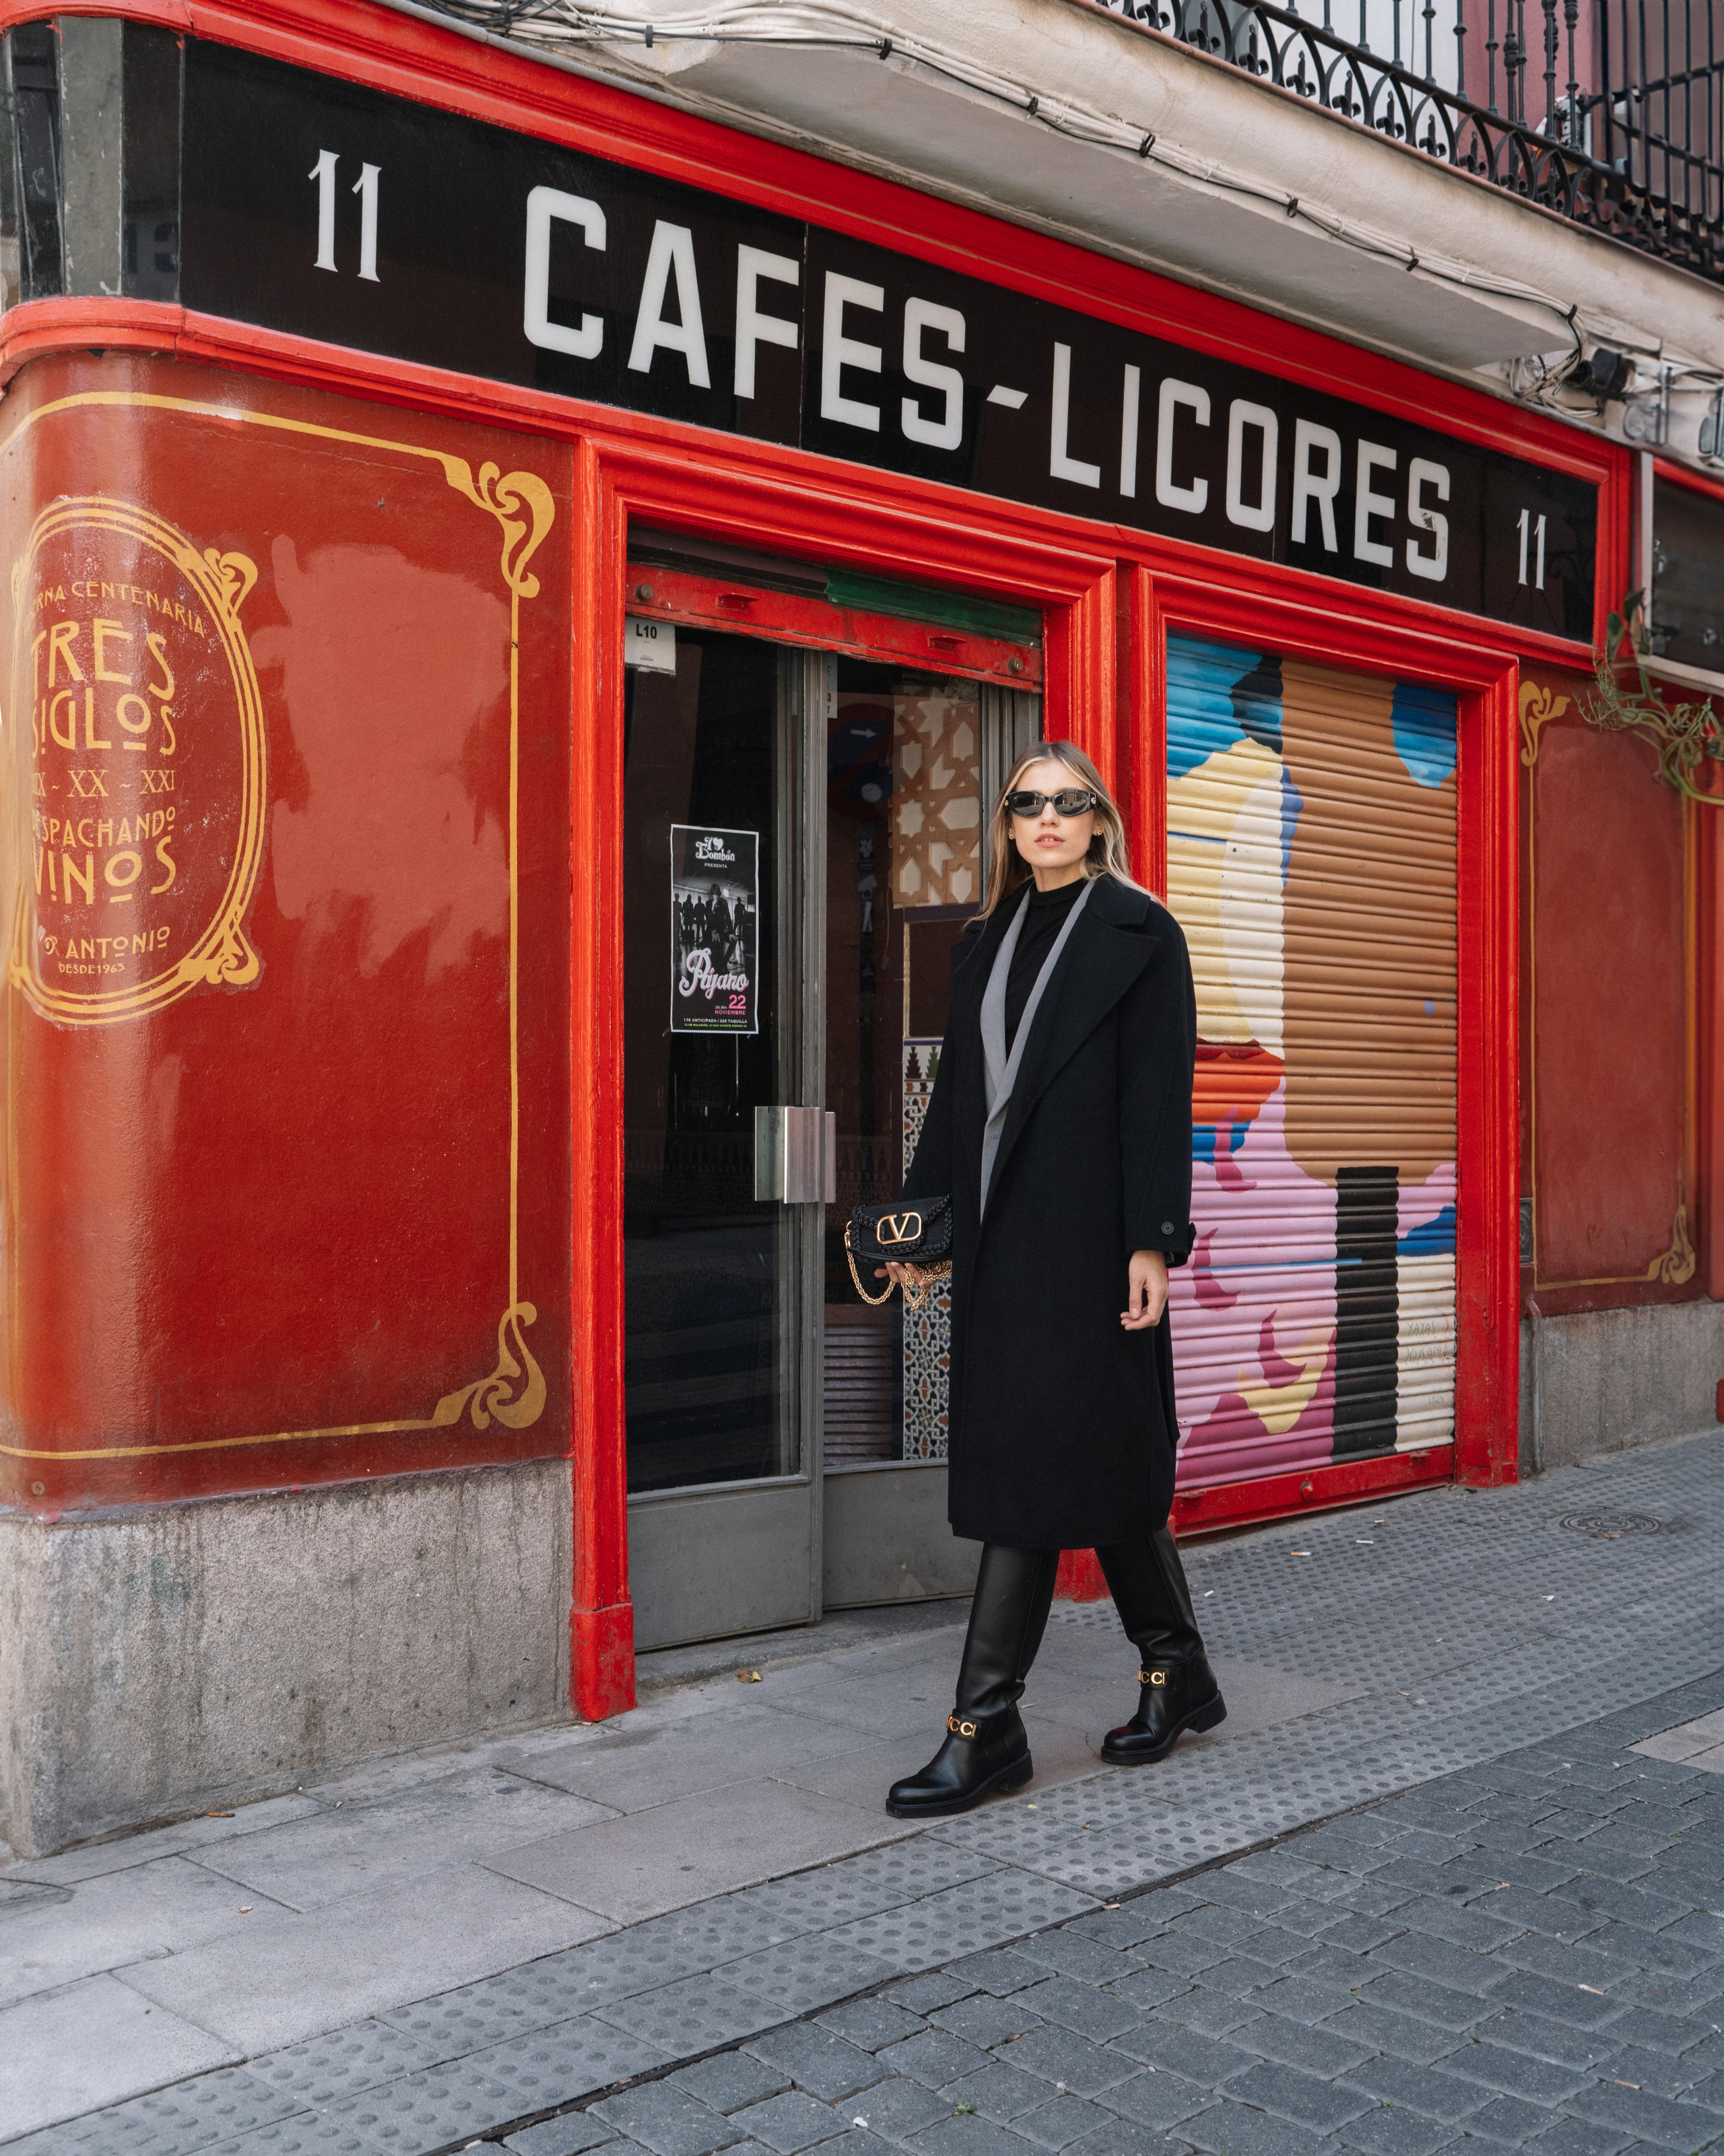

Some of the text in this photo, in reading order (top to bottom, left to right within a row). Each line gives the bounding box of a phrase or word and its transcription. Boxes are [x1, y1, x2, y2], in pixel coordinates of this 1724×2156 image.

[308, 149, 382, 283] 11
[1517, 508, 1546, 590] 11
[71, 581, 205, 639] CENTENARIA
[636, 624, 657, 639] L10
[31, 618, 175, 701] TRES
[67, 769, 109, 797] XX
[140, 769, 176, 795] XXI
[32, 835, 176, 905] VINOS
[66, 925, 170, 959] ANTONIO
[729, 994, 746, 1010] 22
